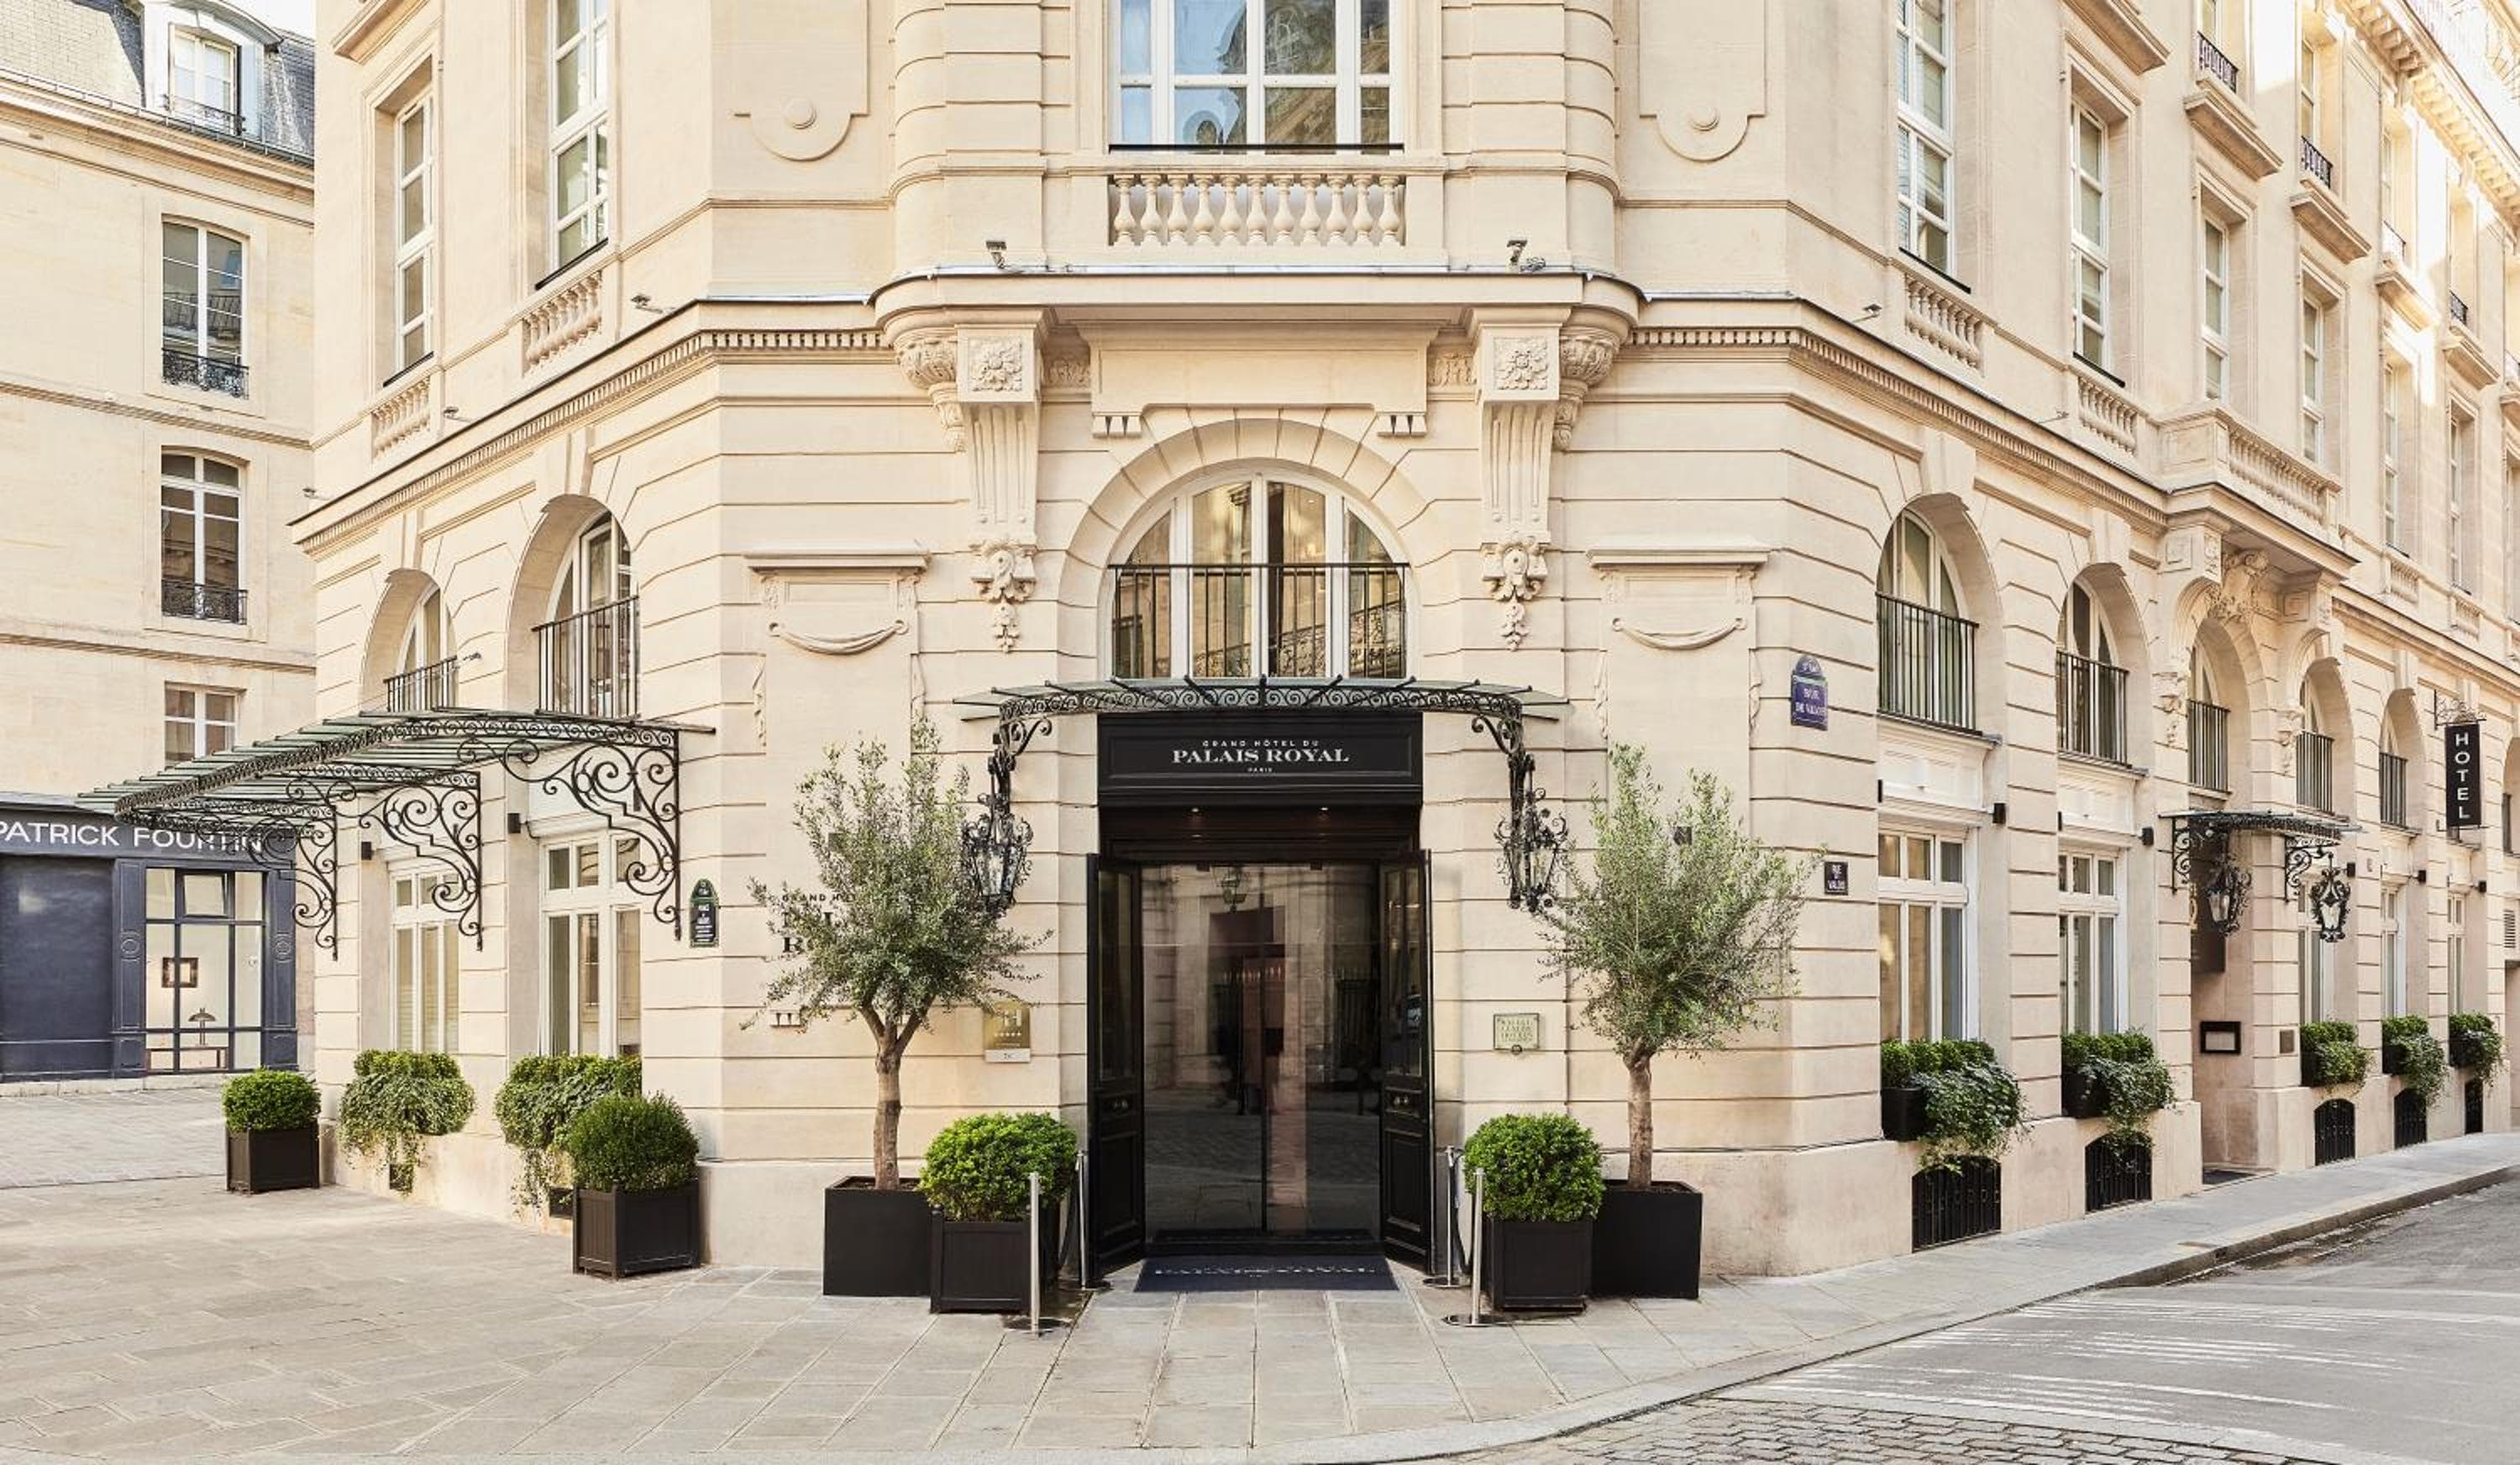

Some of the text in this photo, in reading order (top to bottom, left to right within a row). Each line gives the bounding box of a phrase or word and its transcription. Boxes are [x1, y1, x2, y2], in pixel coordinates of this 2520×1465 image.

[1172, 748, 1349, 763] PALAIS ROYAL
[2454, 732, 2470, 819] HOTEL
